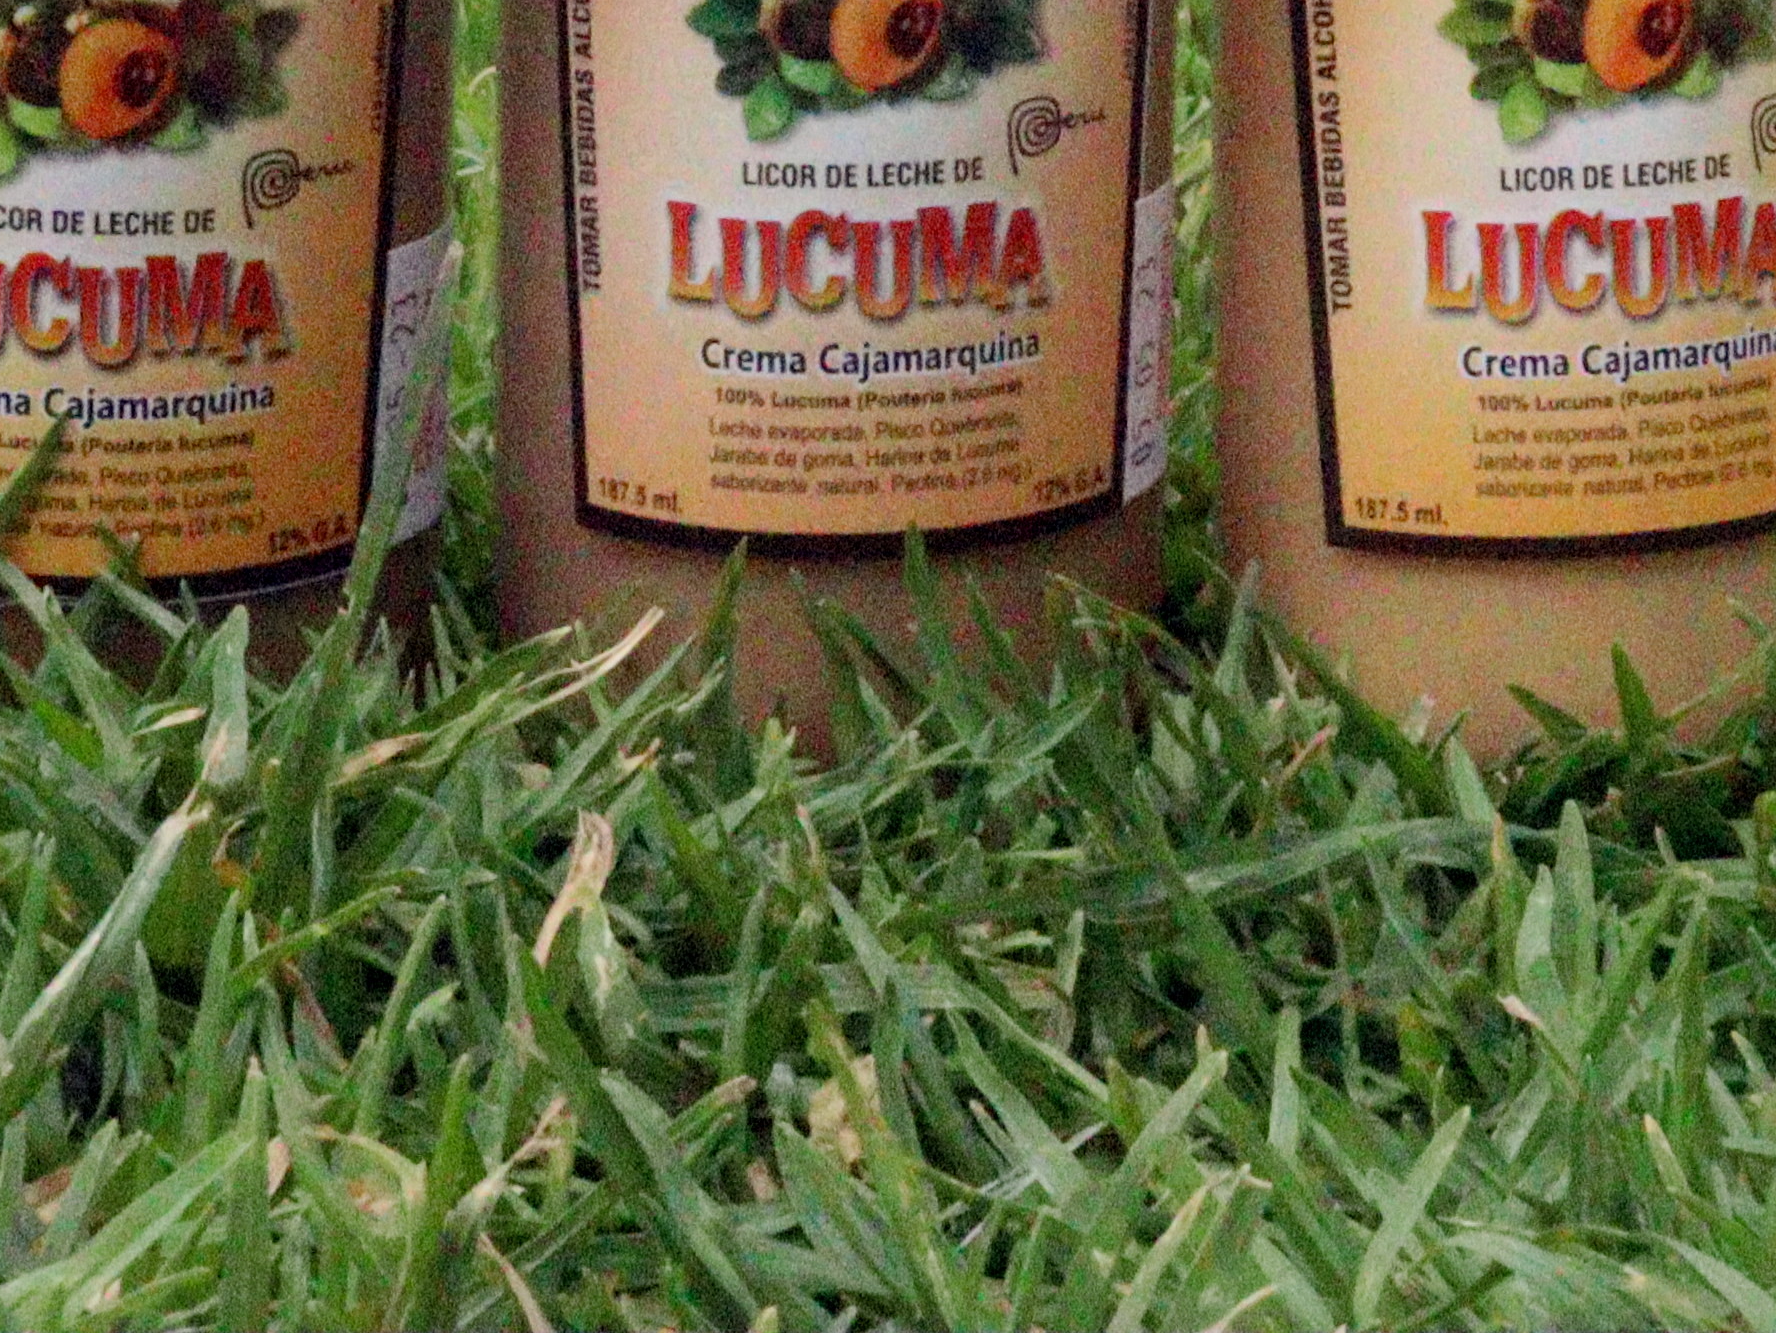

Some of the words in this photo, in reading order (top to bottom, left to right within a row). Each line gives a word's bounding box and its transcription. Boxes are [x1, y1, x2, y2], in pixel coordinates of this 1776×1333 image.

[575, 68, 597, 186] BEBIDAS
[1318, 90, 1347, 208] BEBIDAS
[742, 161, 816, 188] LICOR
[826, 163, 856, 188] DE
[867, 160, 945, 187] LECHE
[954, 156, 983, 183] DE
[1500, 166, 1575, 192] LICOR
[1584, 164, 1613, 189] DE
[1623, 158, 1697, 188] LECHE
[1704, 154, 1730, 180] DE
[53, 209, 84, 233] DE
[93, 210, 174, 236] LECHE
[184, 208, 216, 232] DE
[580, 194, 602, 291] TOMAR
[667, 200, 1049, 321] LUCUMA
[1327, 216, 1353, 314] TOMAR
[702, 338, 807, 375] Crema
[819, 331, 1041, 384] Cajamarquina
[1463, 346, 1571, 378] Crema
[44, 382, 276, 429] Cajamarquina
[771, 391, 850, 410] Lucuma
[1535, 394, 1613, 411] Lucuma
[1355, 496, 1409, 523] 187.5
